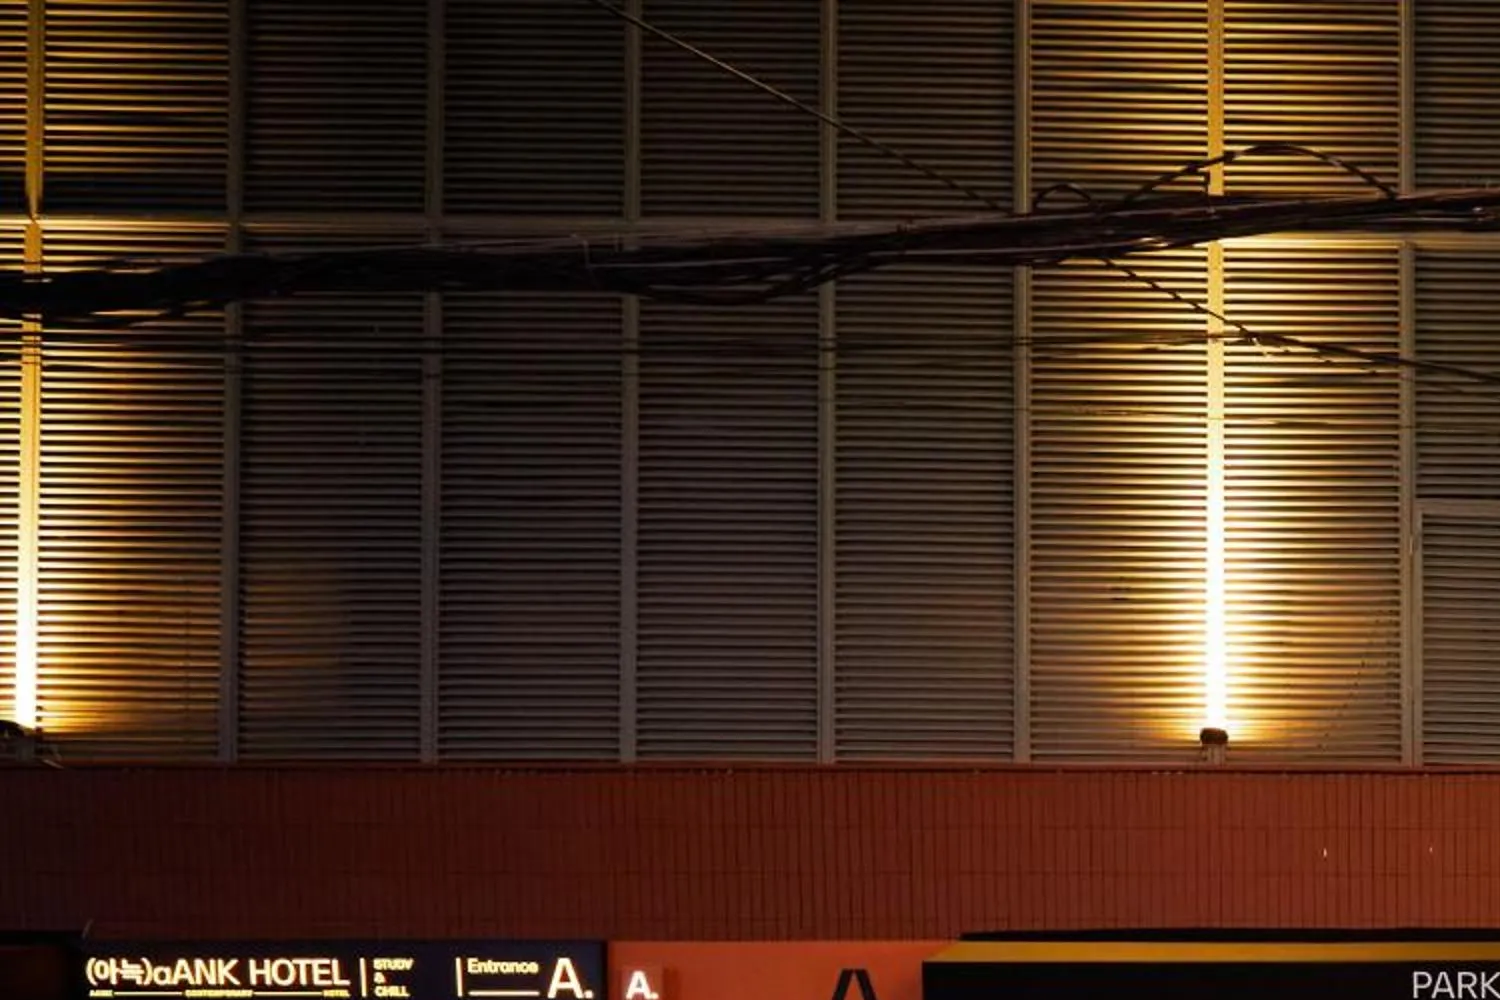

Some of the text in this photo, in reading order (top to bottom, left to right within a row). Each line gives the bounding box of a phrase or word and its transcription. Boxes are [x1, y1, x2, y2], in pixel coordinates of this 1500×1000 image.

[249, 958, 350, 986] HOTEL
[373, 958, 413, 970] STUDY
[375, 985, 410, 997] CHILL
[468, 958, 593, 999] Entrance A.
[626, 971, 659, 1000] A.
